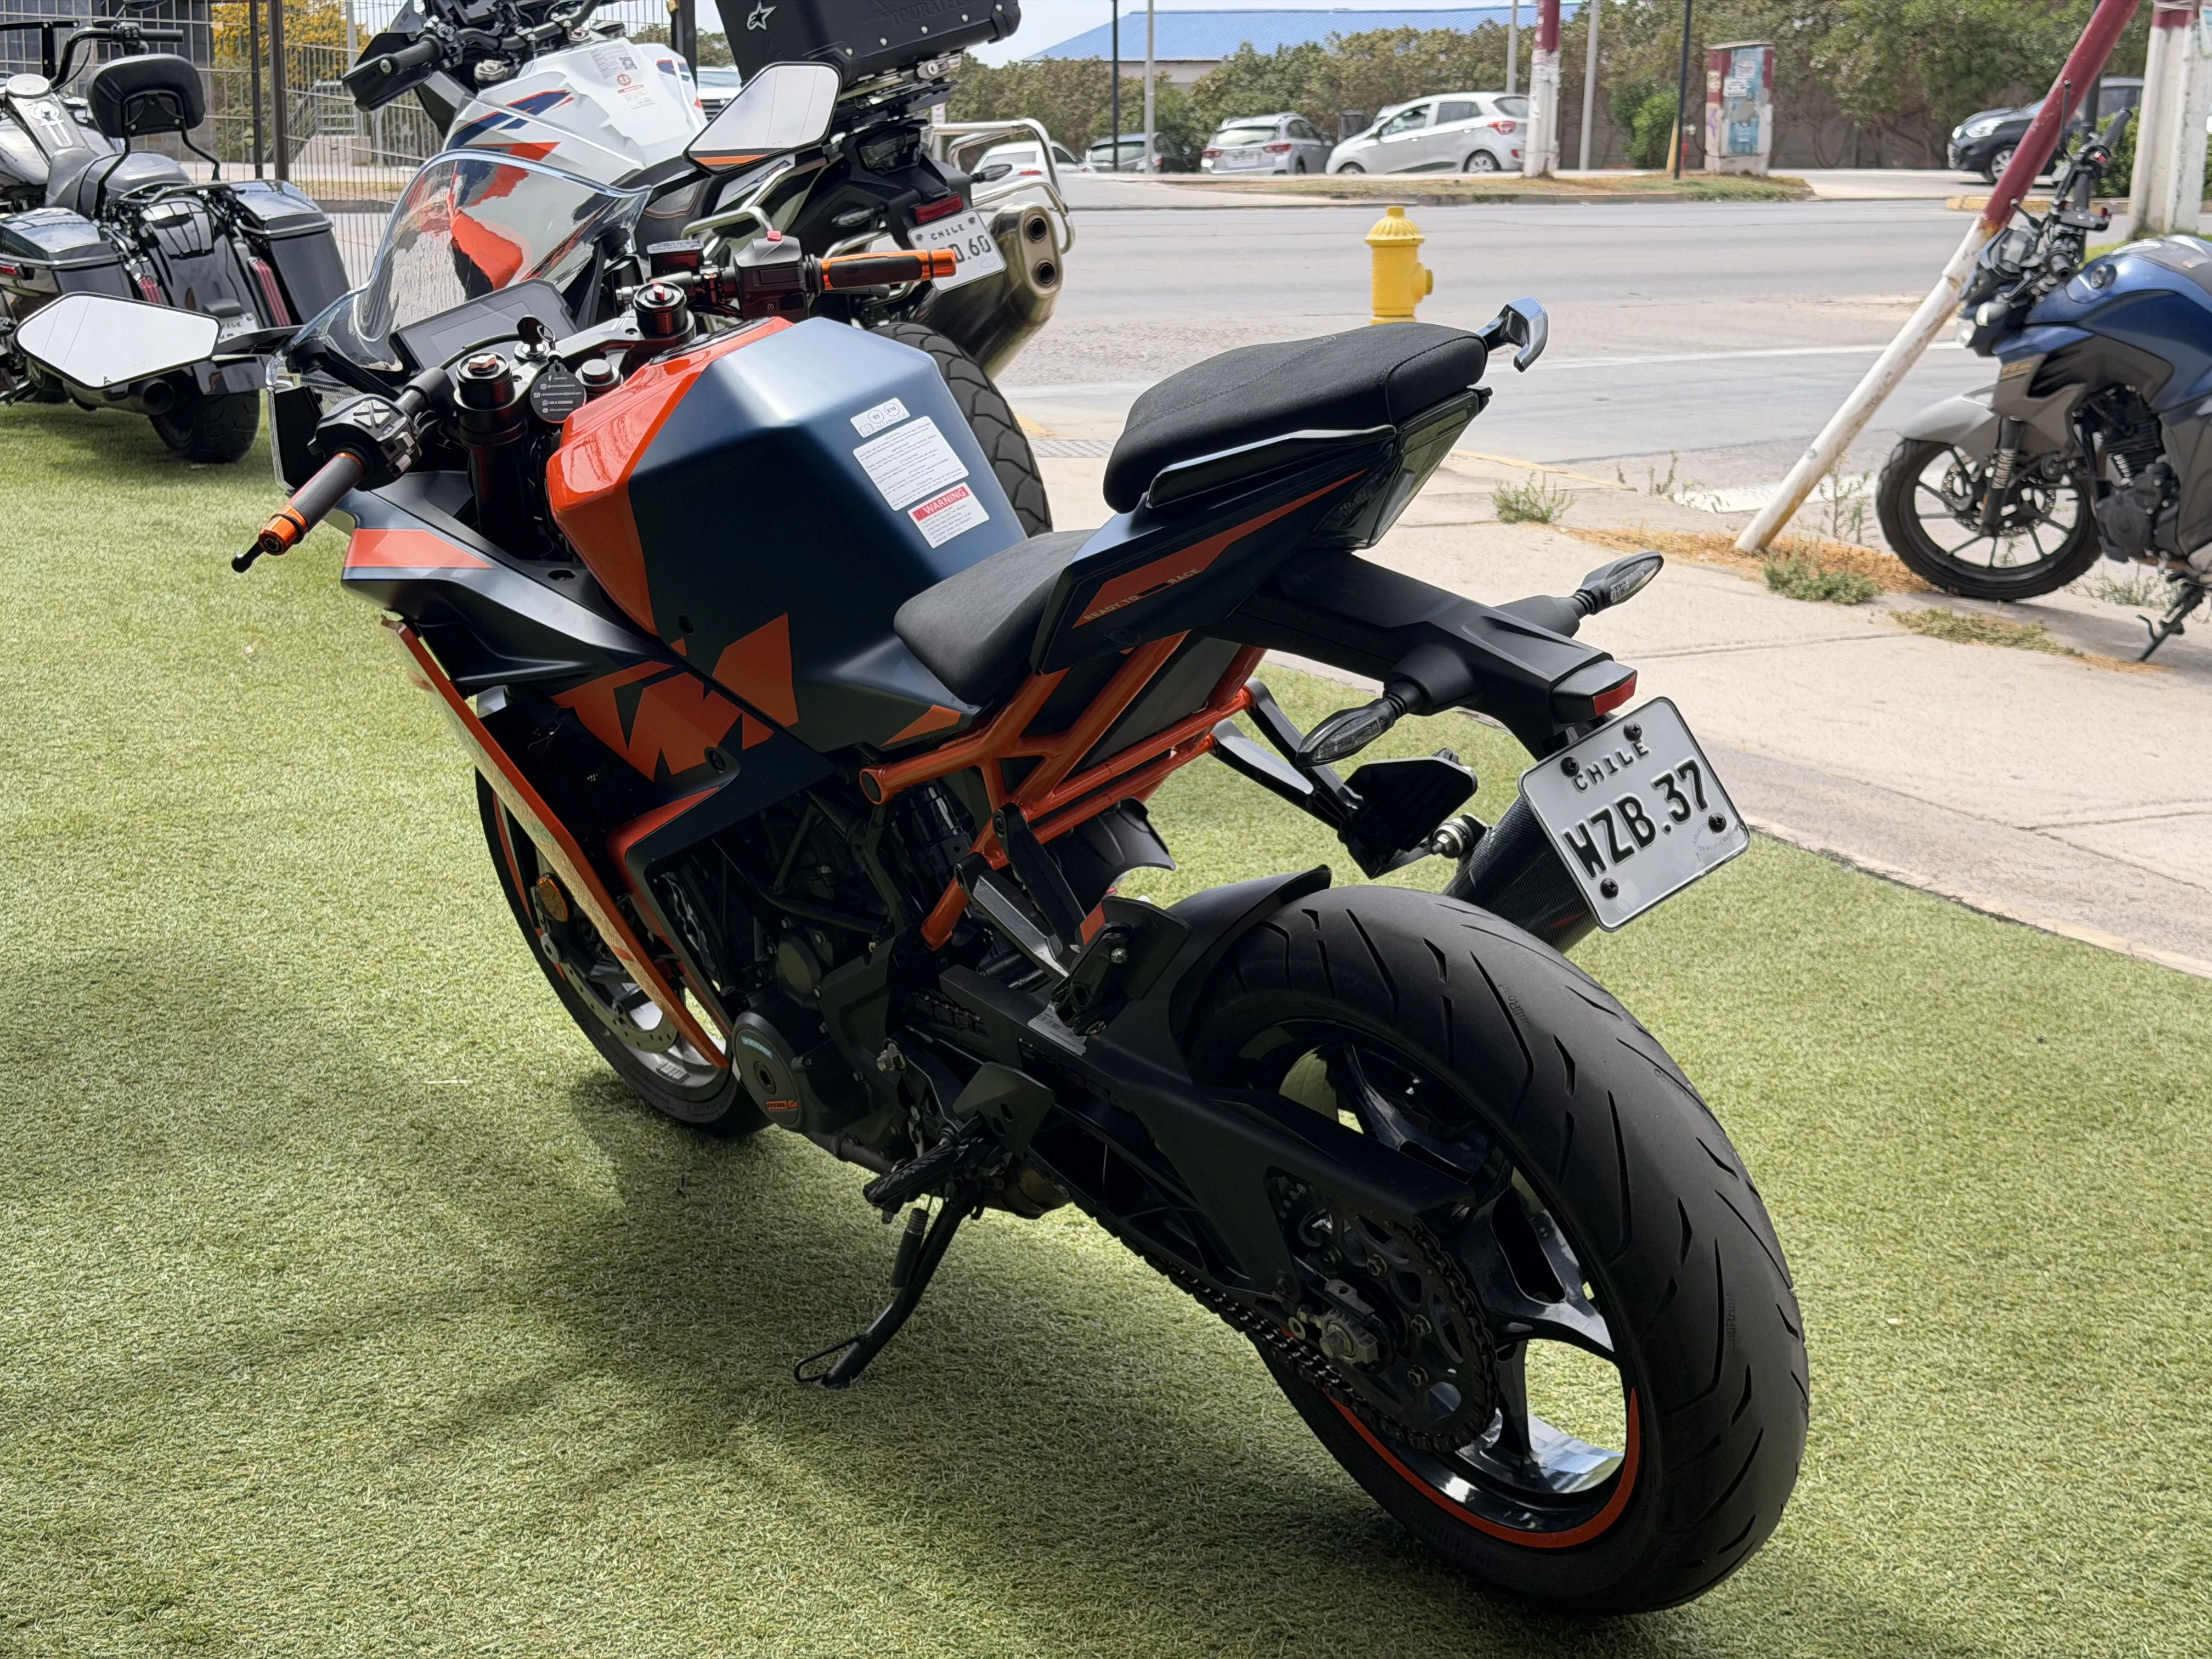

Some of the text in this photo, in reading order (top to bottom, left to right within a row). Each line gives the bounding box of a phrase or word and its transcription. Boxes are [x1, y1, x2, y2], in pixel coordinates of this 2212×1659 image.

[930, 224, 966, 241] CHILE
[1991, 448, 2017, 489] YAMAHA
[923, 487, 967, 515] WARNING
[1084, 568, 1201, 621] READY TO RACE
[1573, 740, 1650, 791] CHILE
[1564, 759, 1709, 878] WZB.37
